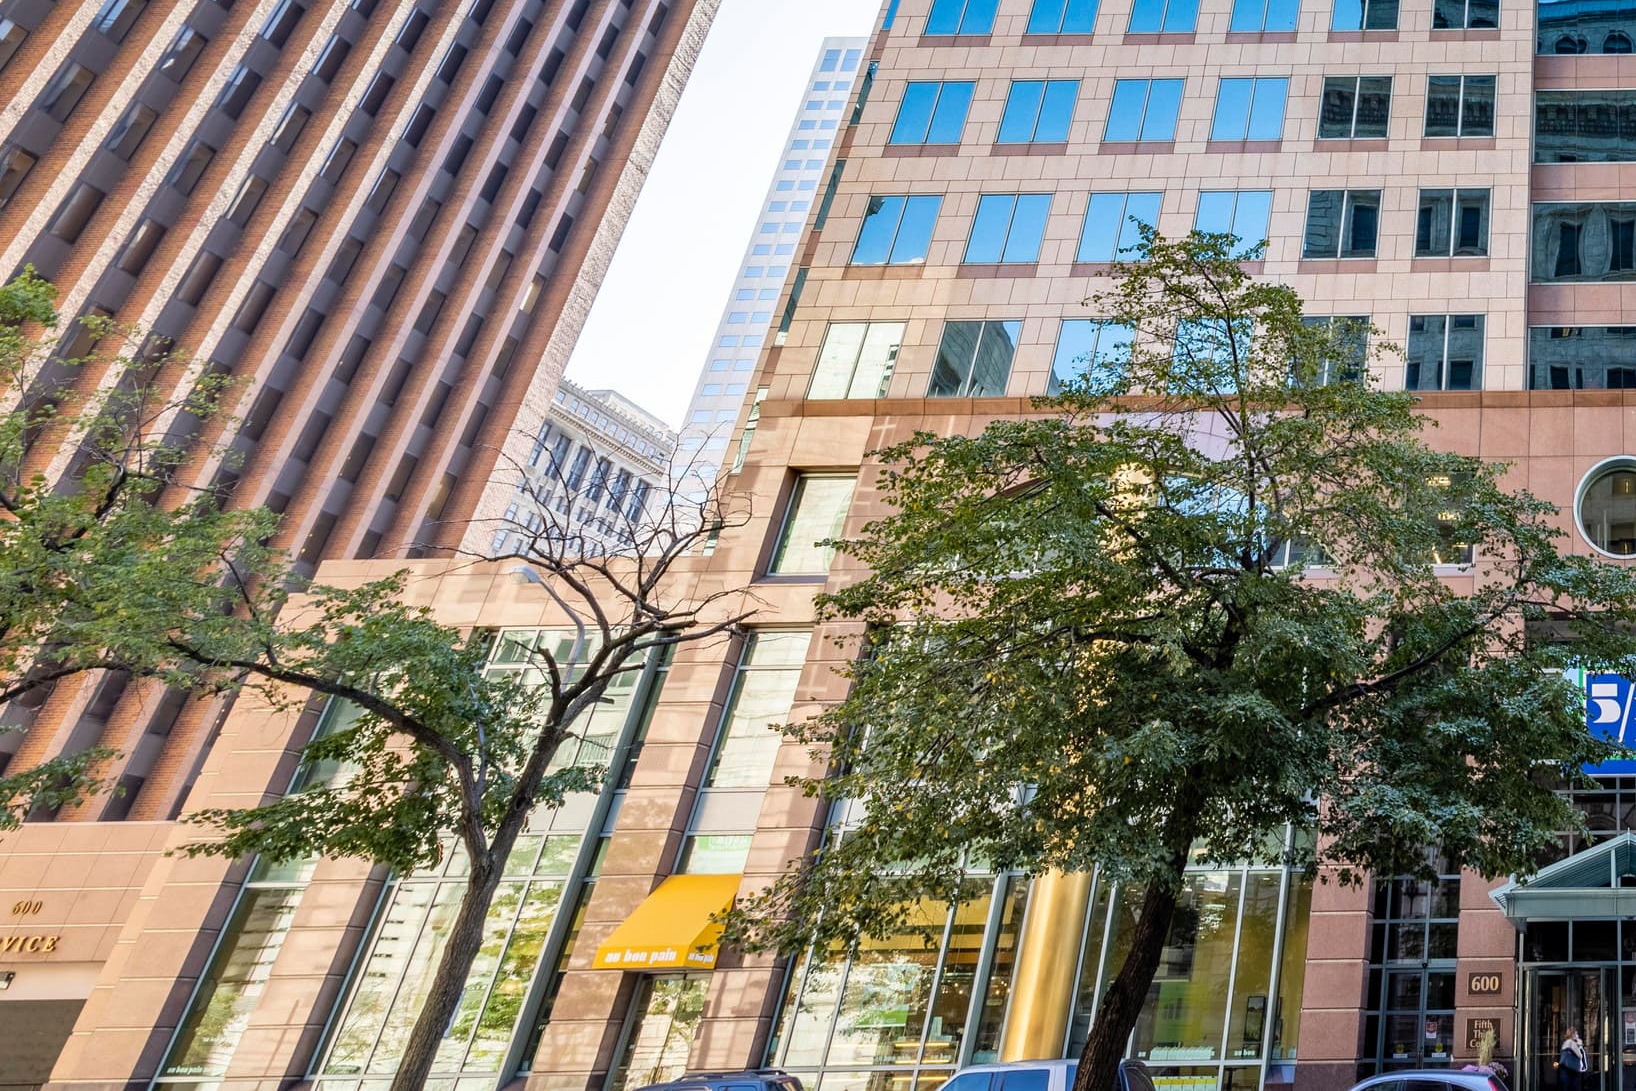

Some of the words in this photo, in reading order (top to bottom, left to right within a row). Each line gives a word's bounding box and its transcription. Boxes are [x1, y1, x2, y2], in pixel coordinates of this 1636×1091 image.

[12, 900, 43, 915] 600
[624, 950, 647, 963] bon
[649, 948, 677, 965] pain
[1471, 976, 1499, 992] 600
[1474, 1019, 1492, 1029] Fifth
